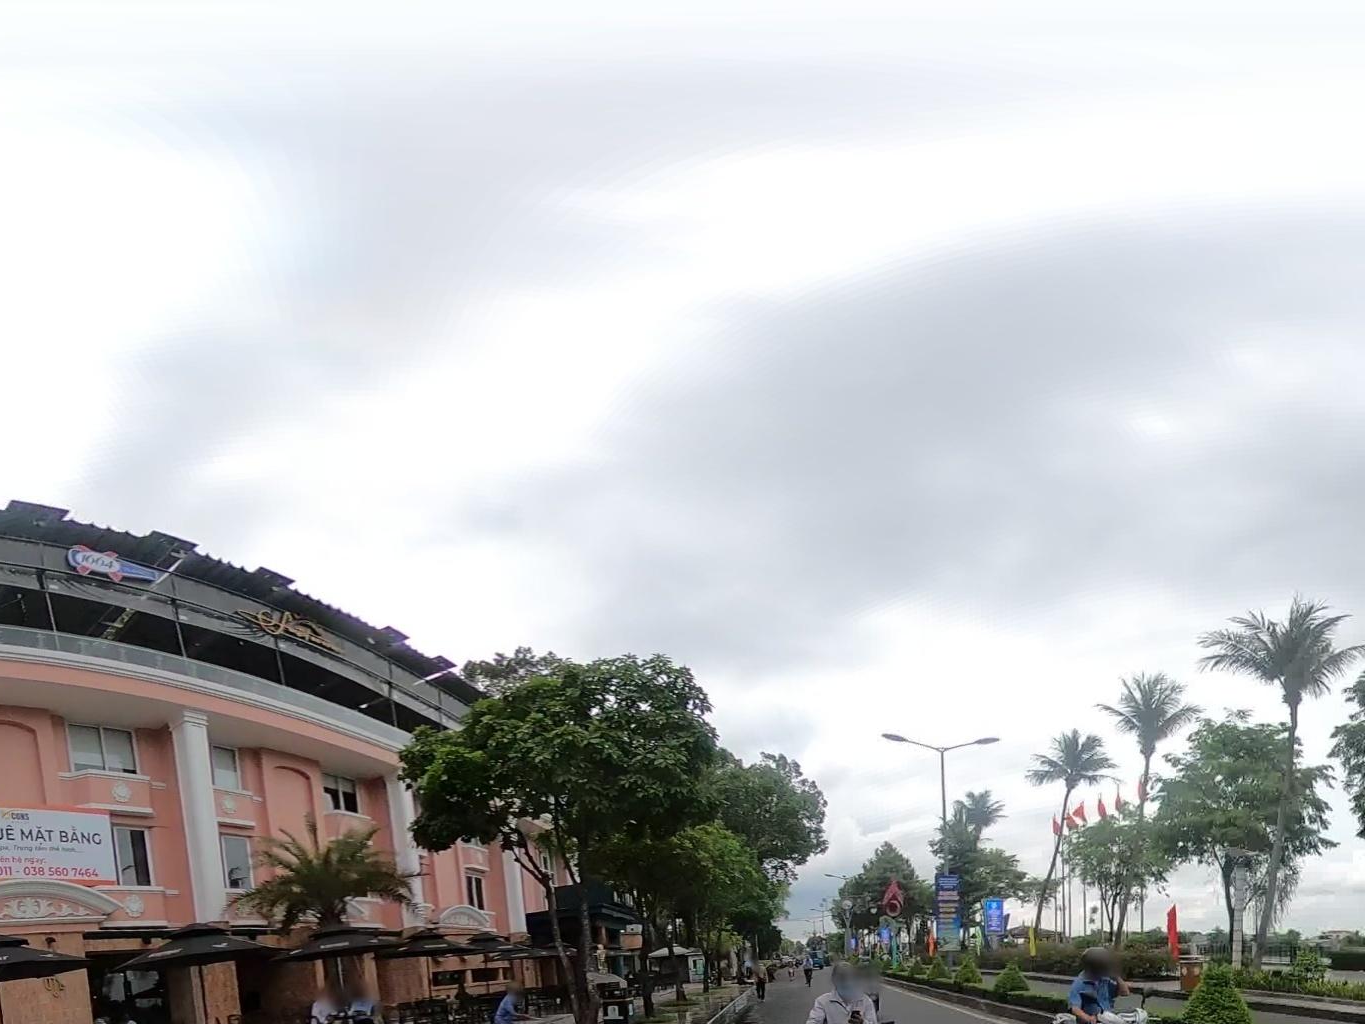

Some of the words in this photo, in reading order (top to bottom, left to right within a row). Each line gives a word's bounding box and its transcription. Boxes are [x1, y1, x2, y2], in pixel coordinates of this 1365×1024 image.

[20, 825, 55, 846] MẶT
[59, 825, 102, 845] BẰNG
[23, 866, 46, 876] 038
[48, 866, 69, 877] 560
[71, 867, 99, 878] 7464
